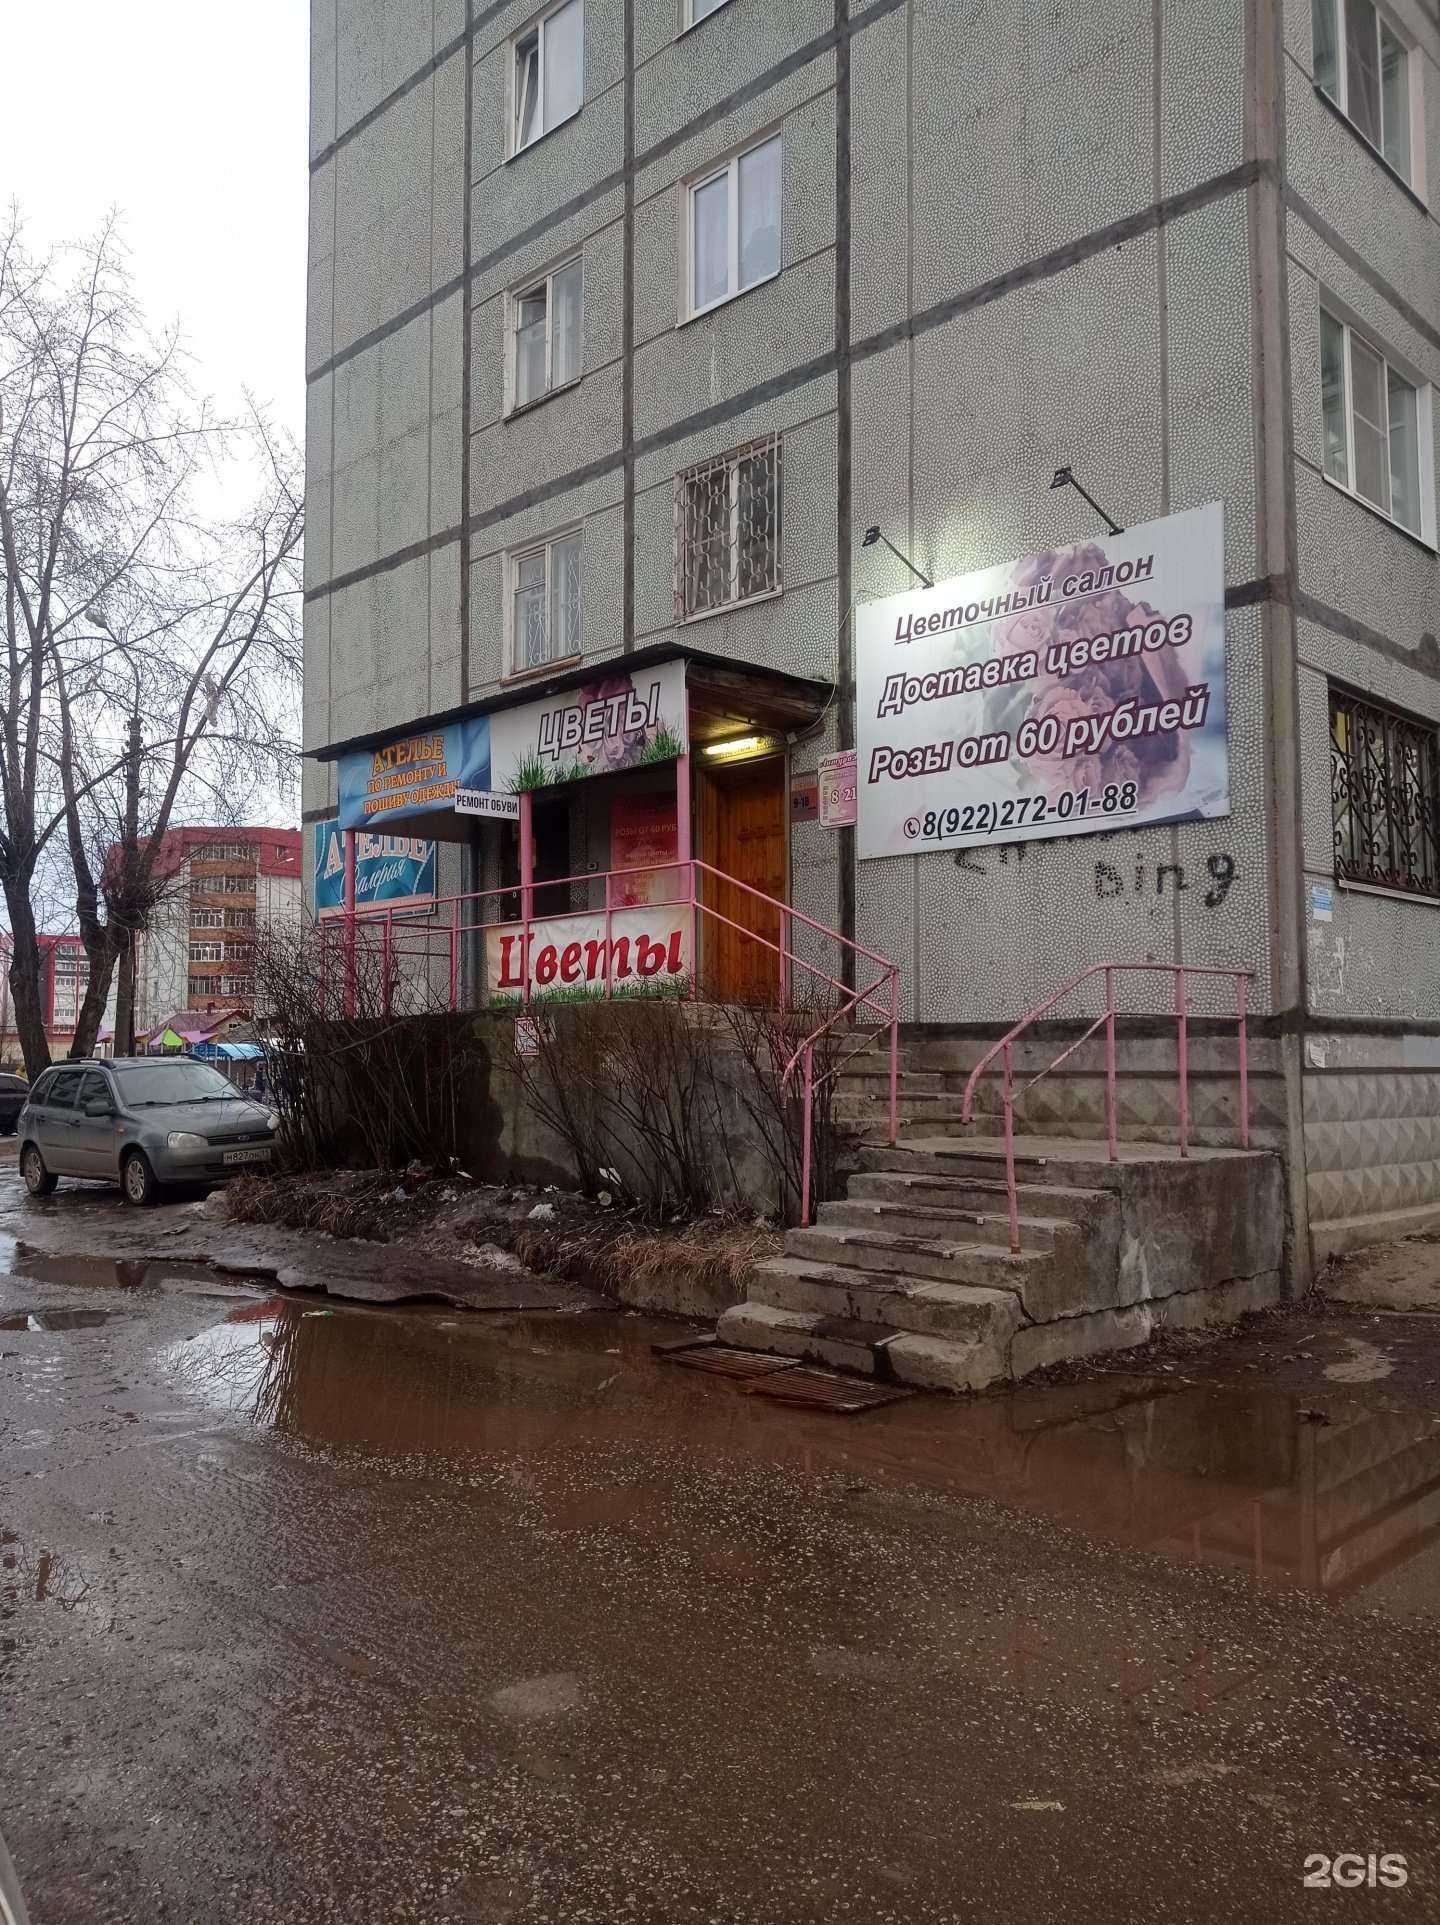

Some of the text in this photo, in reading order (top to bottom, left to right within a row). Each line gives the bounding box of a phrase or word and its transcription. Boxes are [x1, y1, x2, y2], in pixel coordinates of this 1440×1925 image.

[895, 553, 1155, 643] Цветочный салон
[877, 612, 1193, 718] Доставка цветов
[538, 682, 660, 761] ЦВЕТЫ
[868, 682, 1211, 783] Розы от 60 рублей
[366, 762, 448, 794] ПО РЕМОНТУ И
[372, 735, 444, 776] АТЕЛЬЕ
[364, 794, 411, 815] ПОШИВУ
[456, 794, 518, 814] РЕМОНТ ОБУВИ
[921, 781, 1138, 840] 8(922)272-01-88
[323, 831, 428, 880] АЕЛЬЕ
[497, 930, 683, 1001] Цветы
